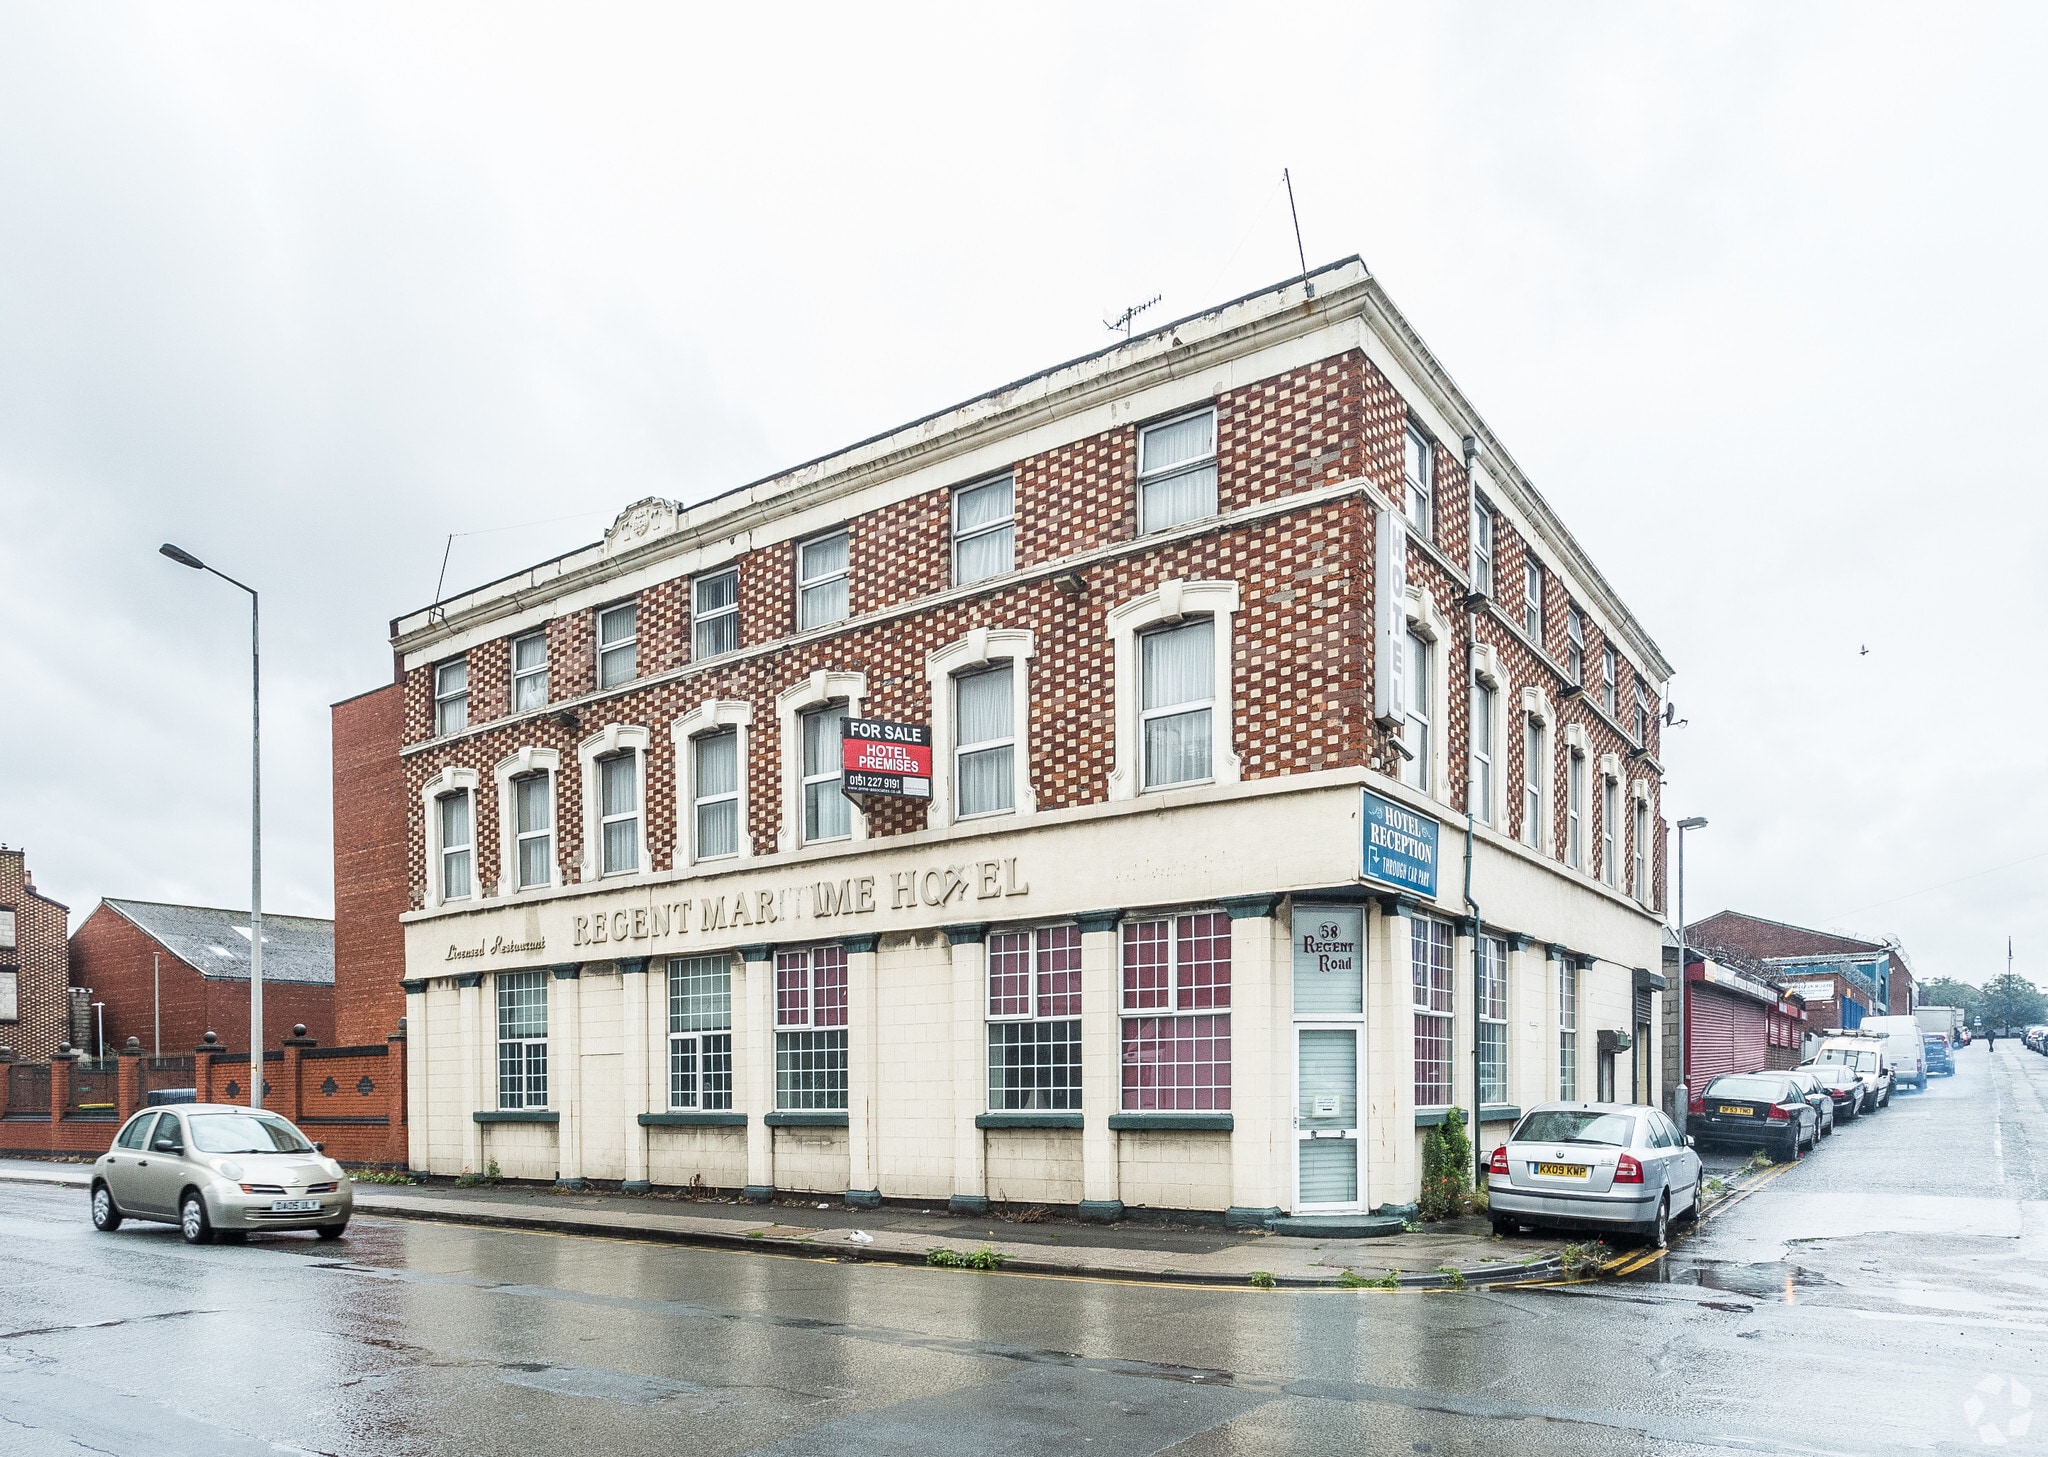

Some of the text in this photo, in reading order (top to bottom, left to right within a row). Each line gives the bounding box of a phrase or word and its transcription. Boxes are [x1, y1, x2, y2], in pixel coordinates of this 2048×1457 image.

[1392, 524, 1403, 713] HOTEL
[850, 722, 922, 742] FOR SALE
[866, 744, 911, 760] HOTEL
[859, 756, 919, 773] PREMISES
[849, 775, 900, 789] 0151 227 9191
[1385, 806, 1421, 838] HOTEL
[1370, 822, 1432, 864] RECEPTION
[1382, 856, 1430, 888] THROUGH CAR PARK
[572, 898, 693, 947] REGENT
[890, 856, 1030, 909] HOTEL
[1321, 925, 1338, 939] 58
[444, 935, 546, 961] Licensed Restaurant
[1318, 954, 1352, 972] Road
[1540, 1164, 1586, 1176] KX09 KWP
